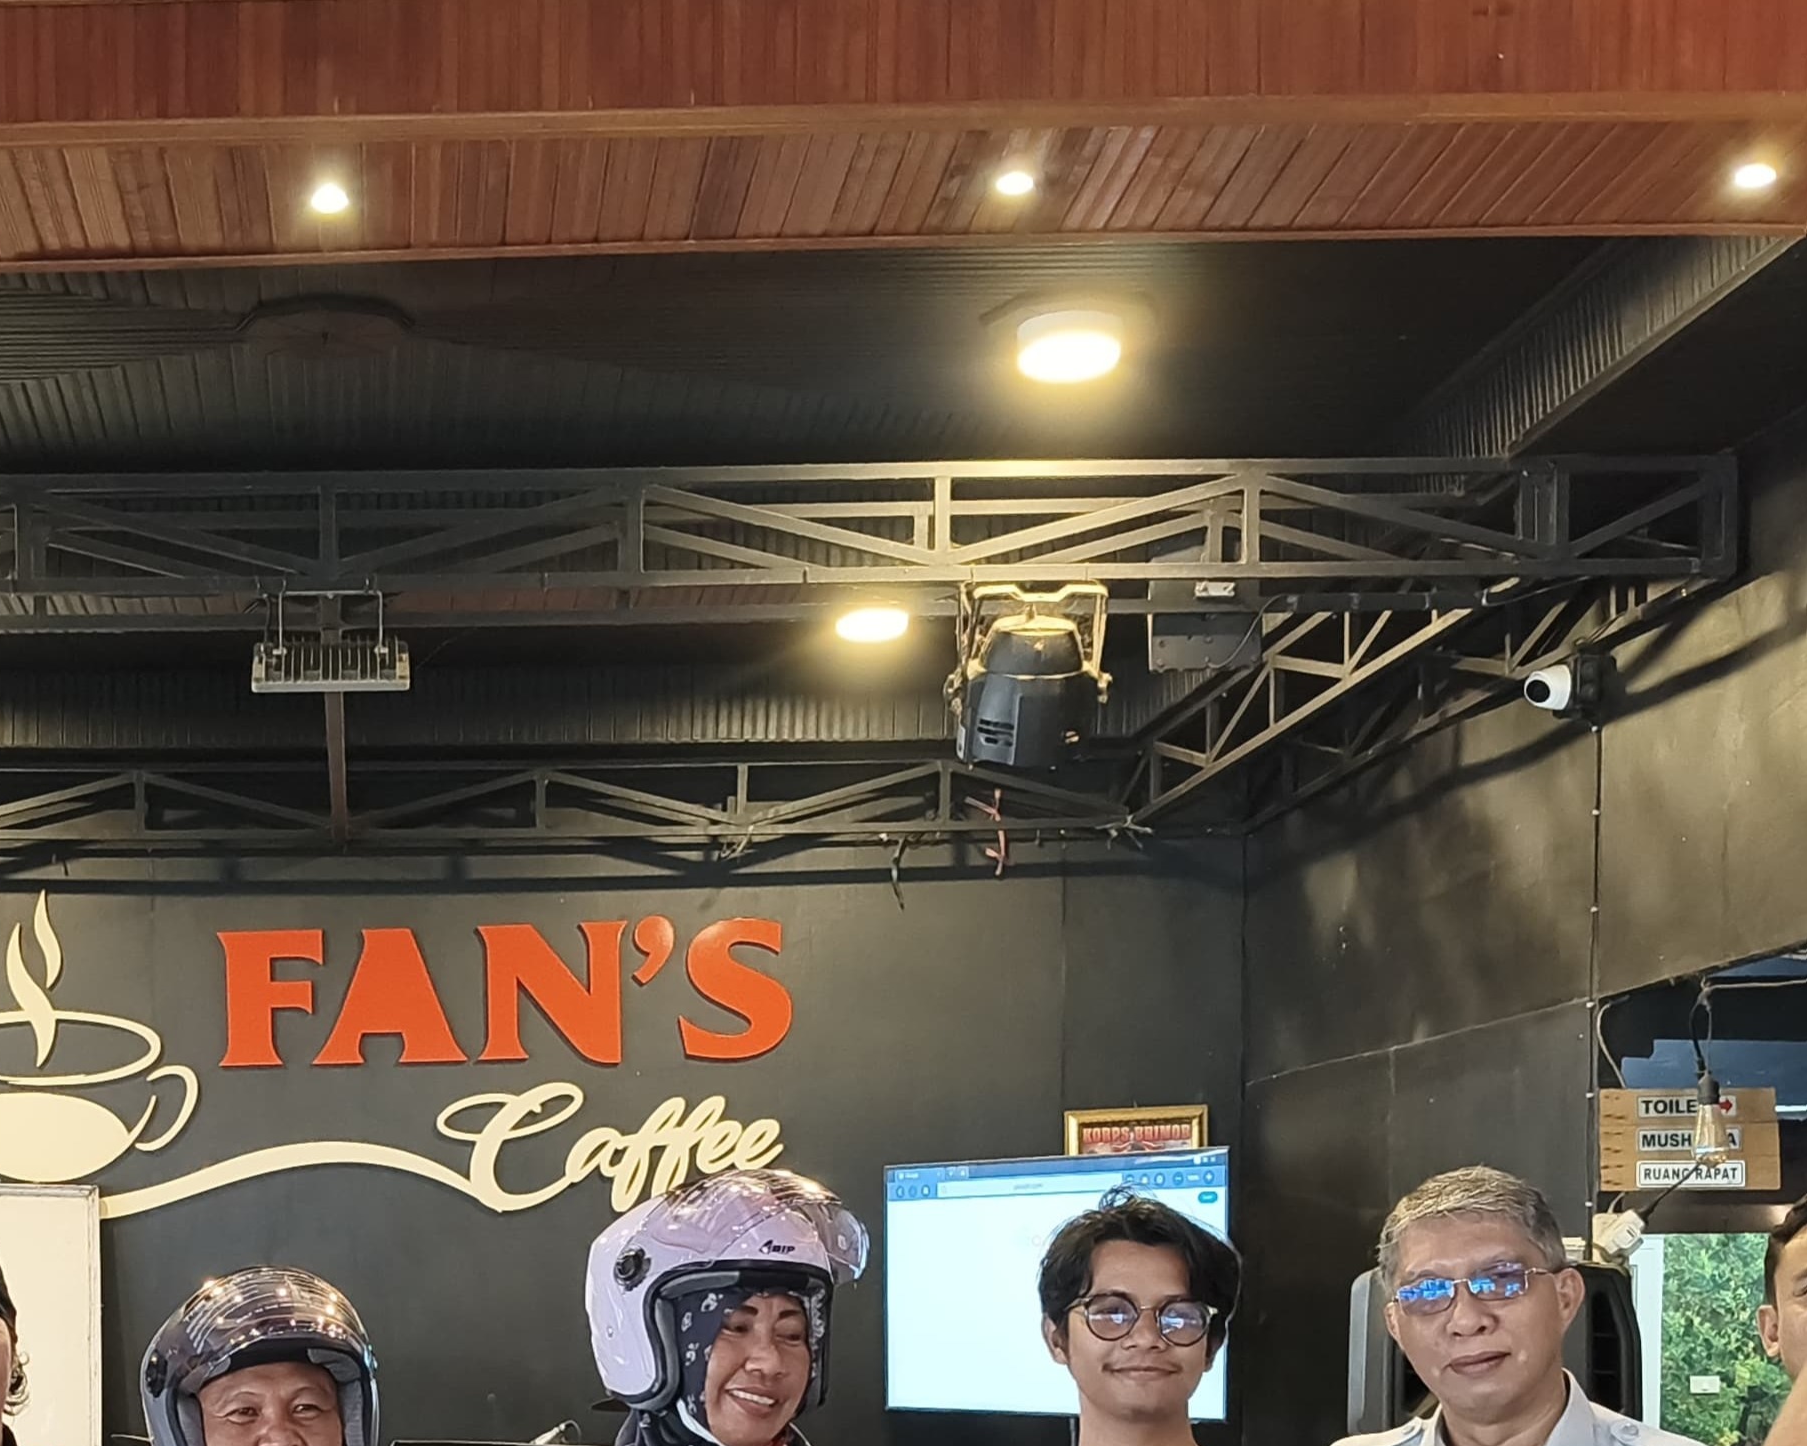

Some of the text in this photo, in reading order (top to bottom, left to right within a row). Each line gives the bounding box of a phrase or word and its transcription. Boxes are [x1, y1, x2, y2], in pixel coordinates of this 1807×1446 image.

[216, 915, 793, 1068] FAN'S
[1641, 1099, 1697, 1115] TOILE
[1695, 1167, 1738, 1181] RAPAT
